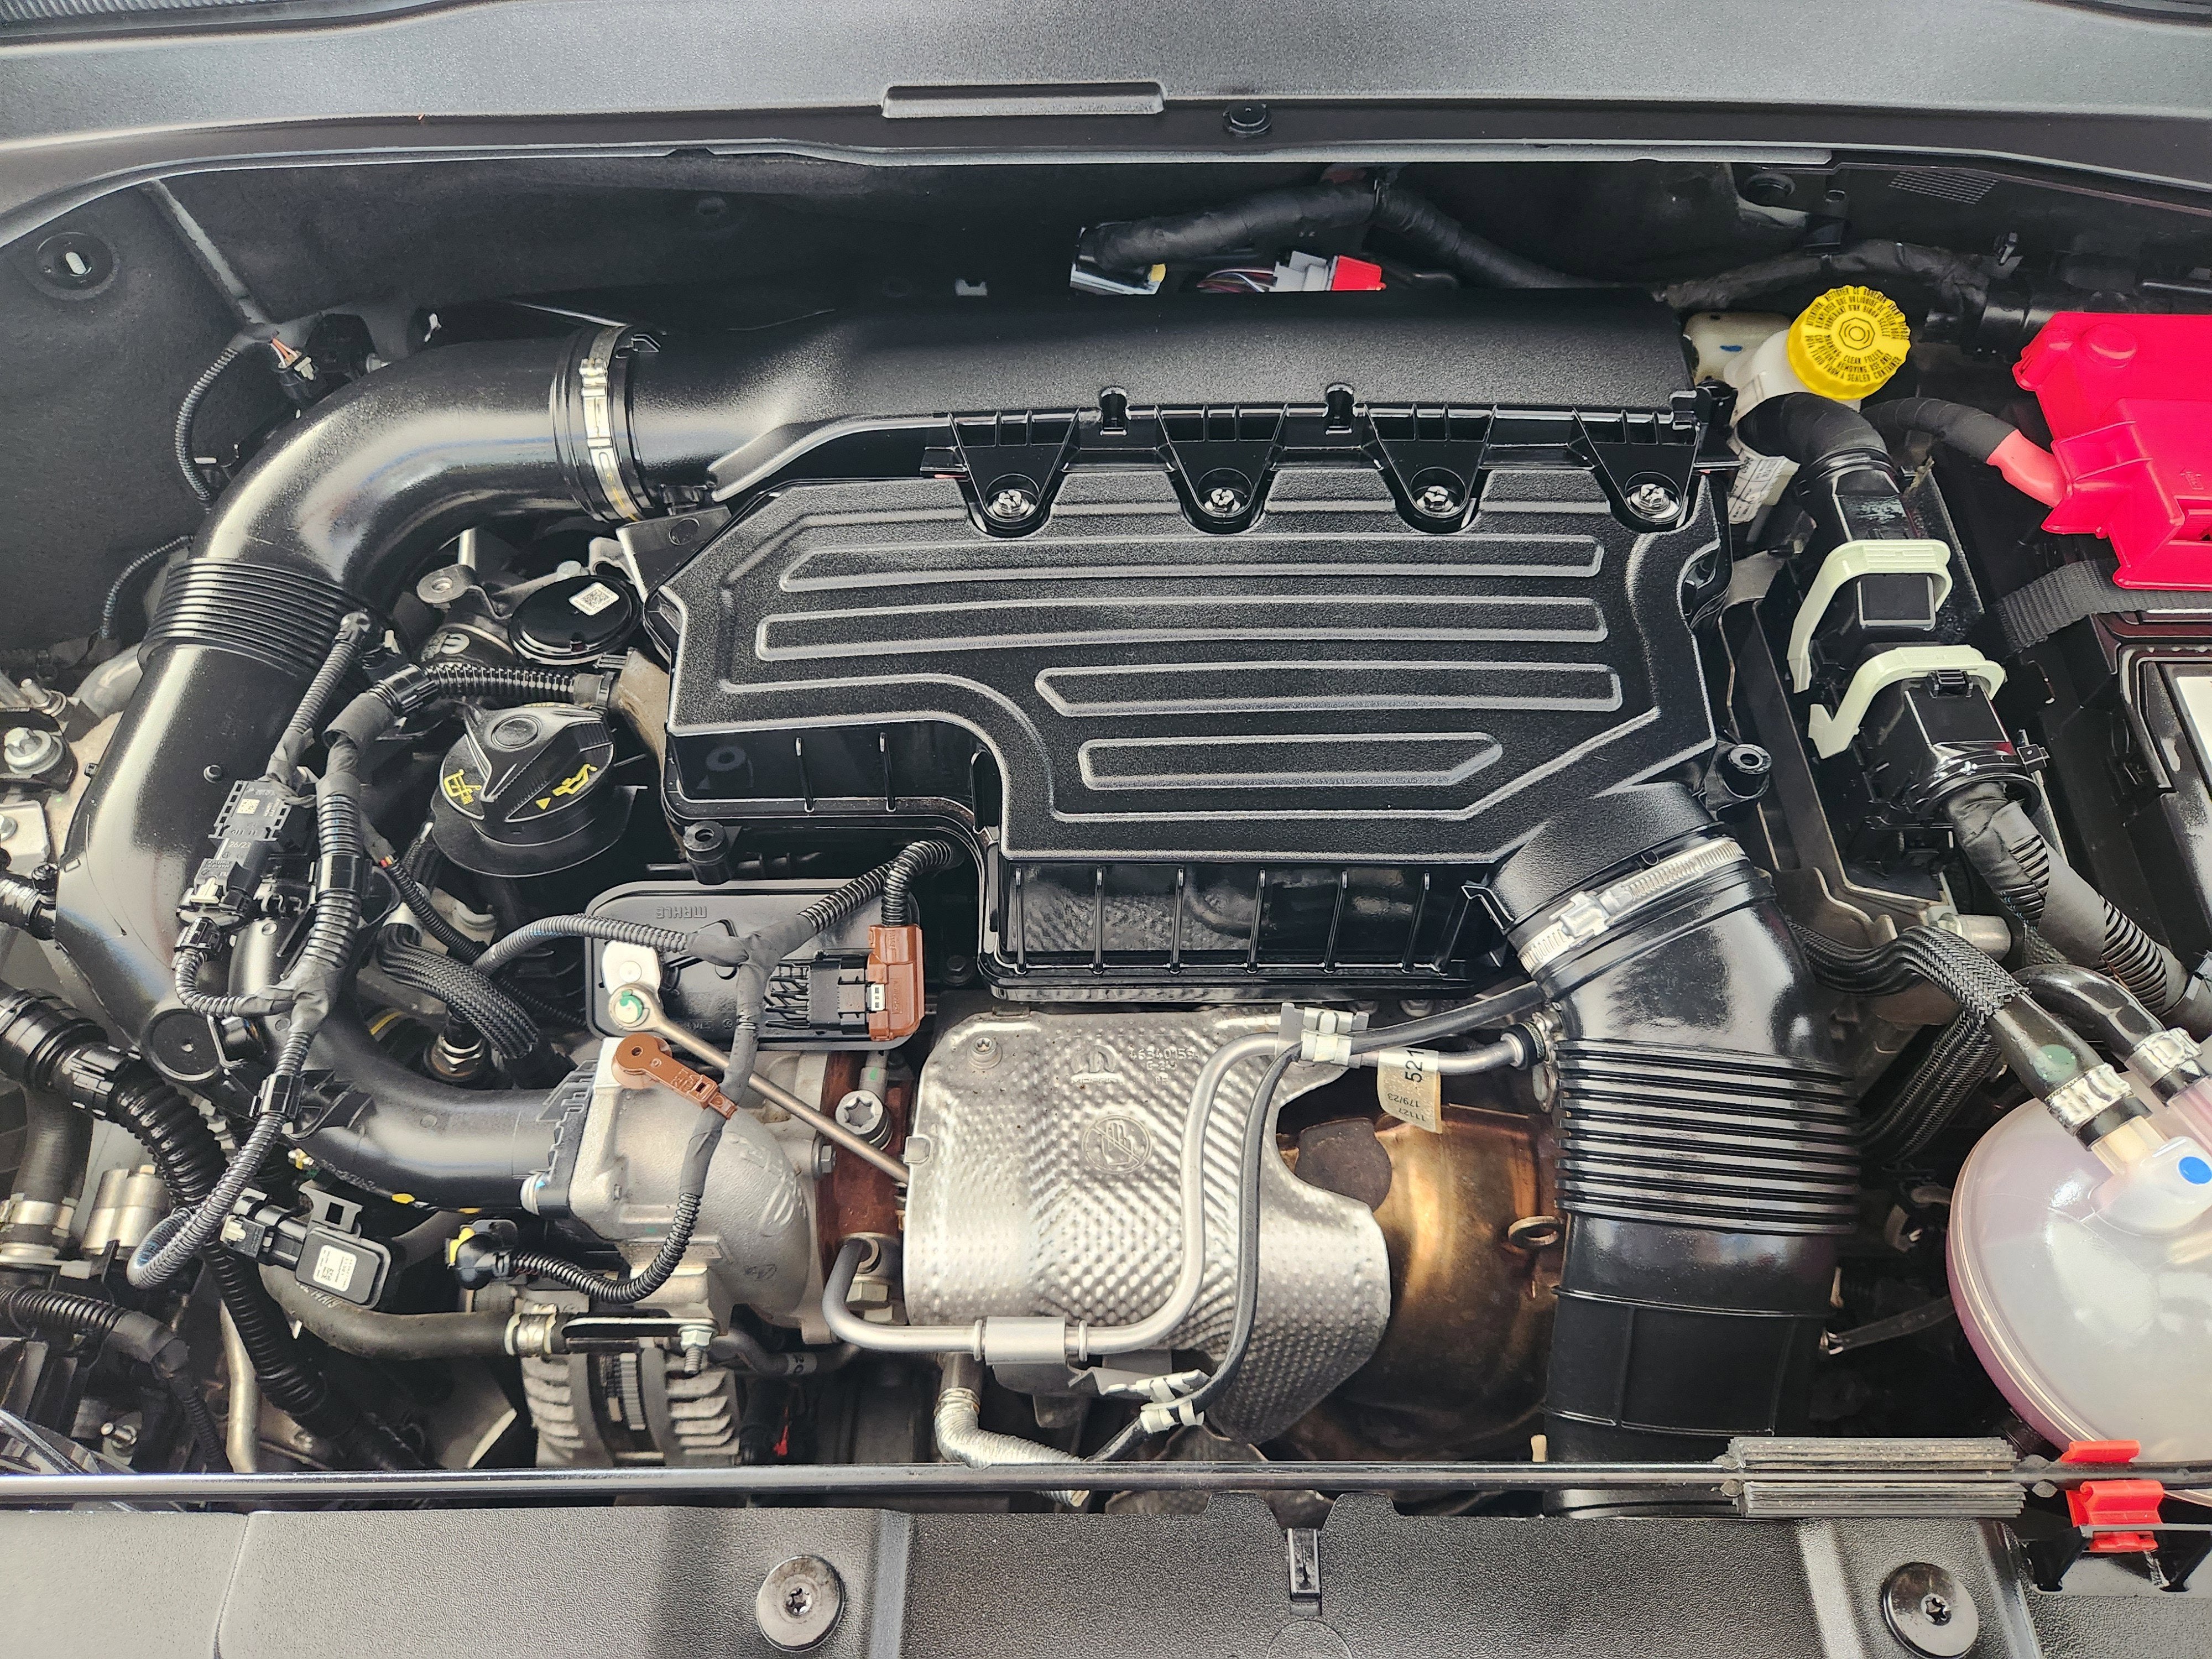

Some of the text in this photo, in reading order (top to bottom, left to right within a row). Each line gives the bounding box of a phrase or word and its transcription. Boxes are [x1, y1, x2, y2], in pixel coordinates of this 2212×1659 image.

[655, 905, 708, 919] MAHLE
[1405, 1049, 1425, 1083] 521
[1387, 1093, 1421, 1108] 179/23
[1398, 1108, 1427, 1122] 11127
